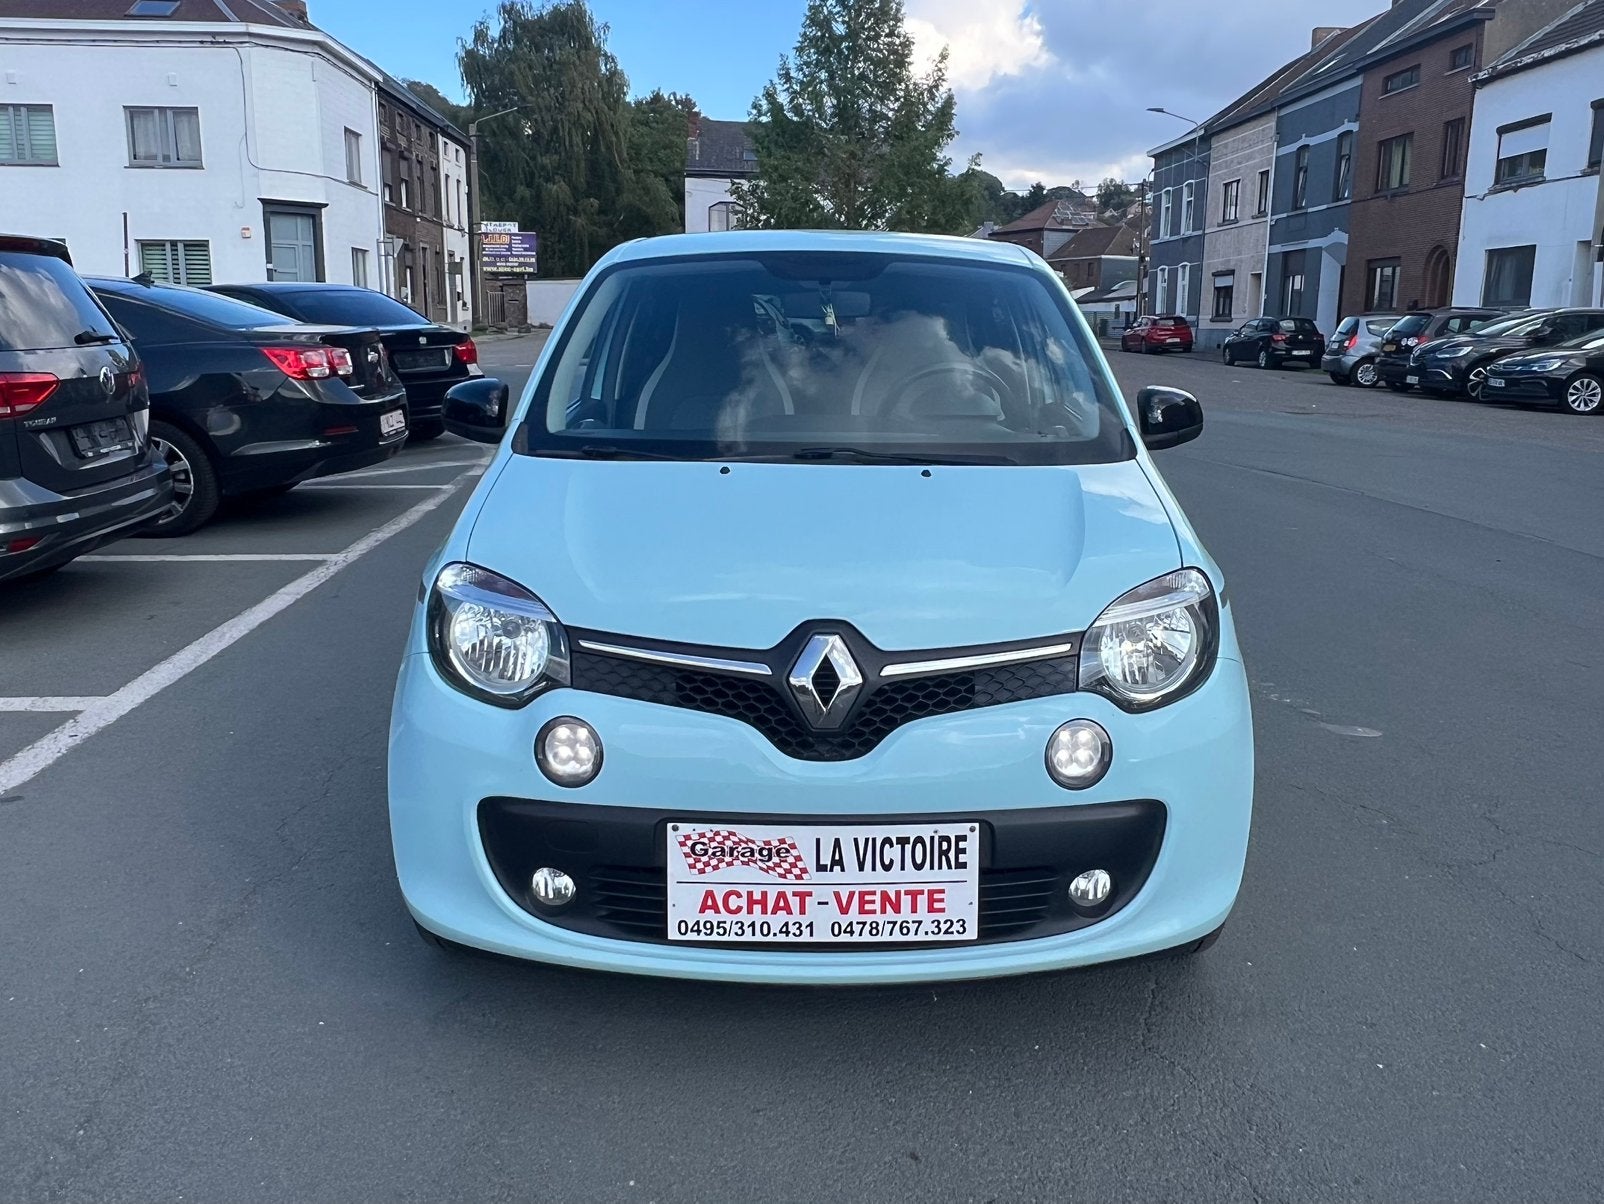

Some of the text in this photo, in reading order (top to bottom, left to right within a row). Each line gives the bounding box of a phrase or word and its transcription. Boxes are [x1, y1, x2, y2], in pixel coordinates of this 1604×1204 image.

[690, 834, 968, 873] Garage LA VICTOIRE
[677, 918, 967, 938] 0495/310.431 0478/767.323
